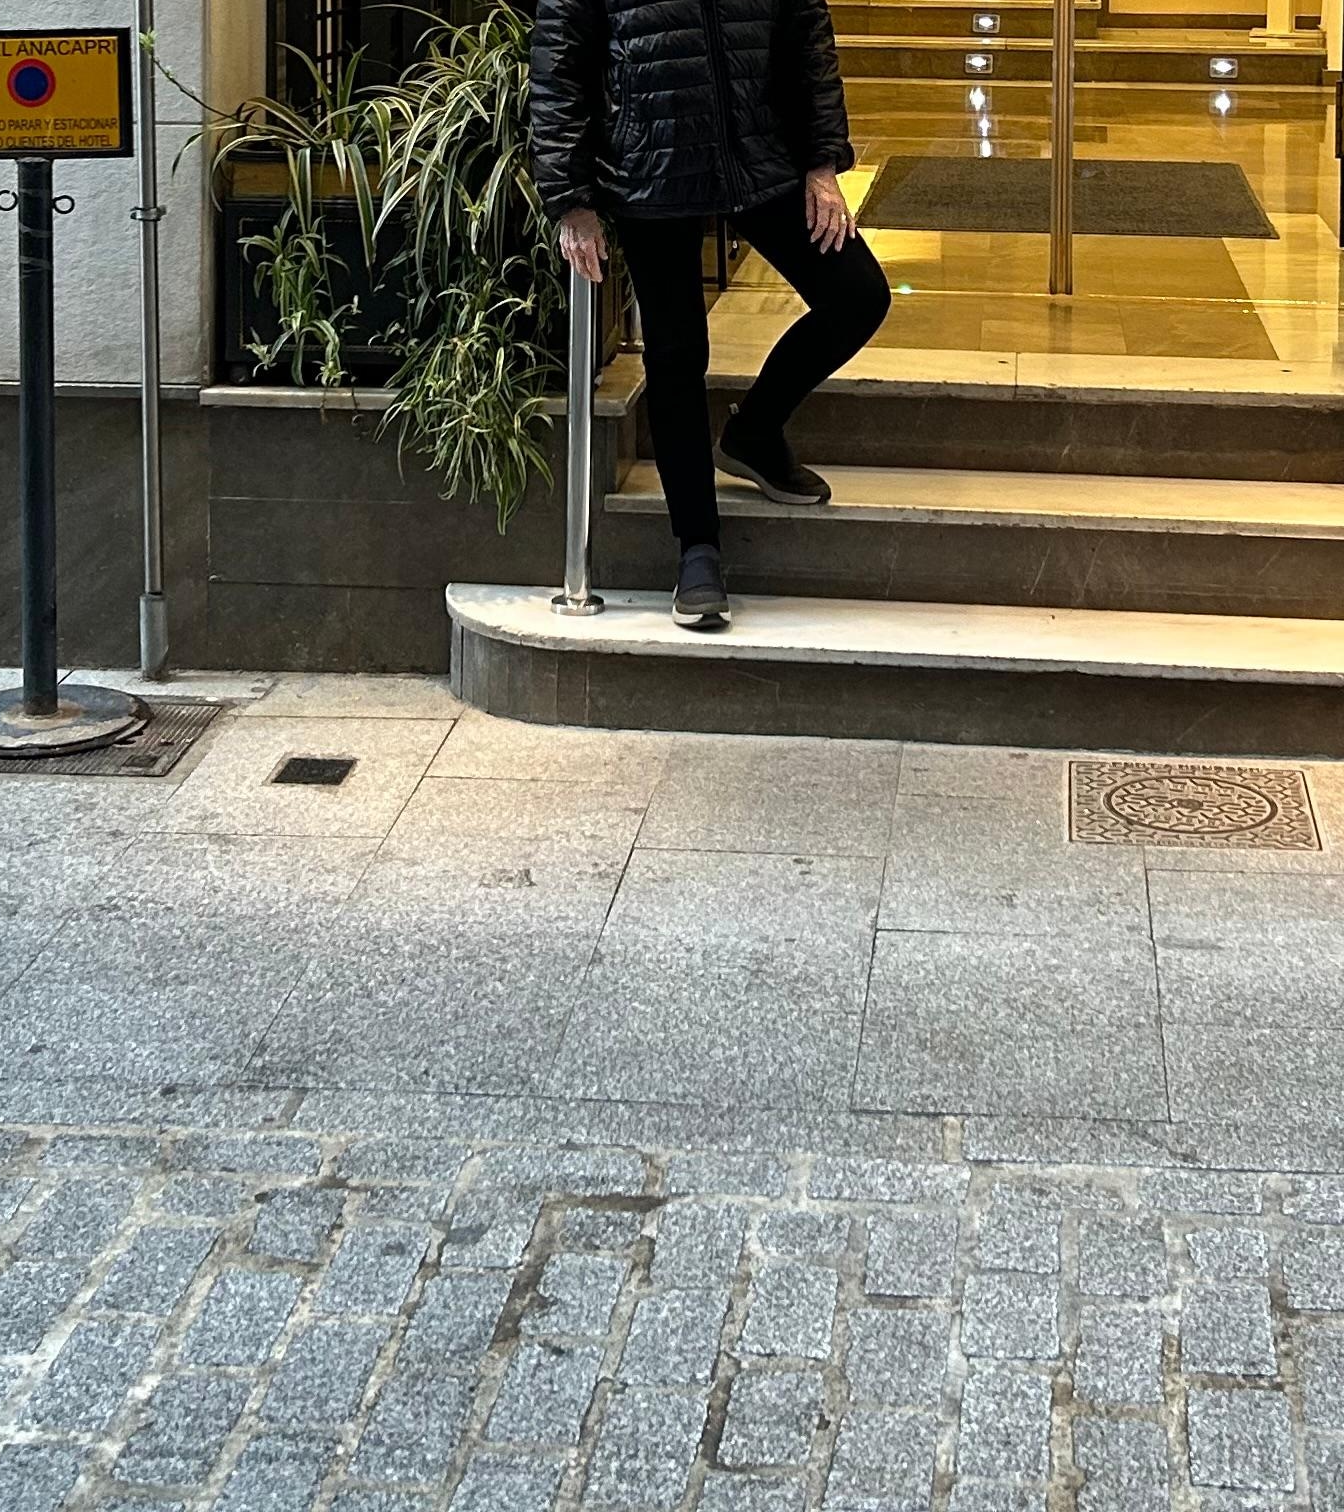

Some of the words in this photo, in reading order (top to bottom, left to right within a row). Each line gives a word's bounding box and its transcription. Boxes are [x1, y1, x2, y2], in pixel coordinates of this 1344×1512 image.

[16, 39, 117, 56] ANACAPRI
[8, 119, 42, 131] PARAR
[43, 118, 53, 130] Y
[53, 117, 118, 130] ESTACIONAR
[4, 136, 56, 149] CLIENTES
[57, 136, 78, 148] DEL
[79, 135, 113, 148] HOTEL
